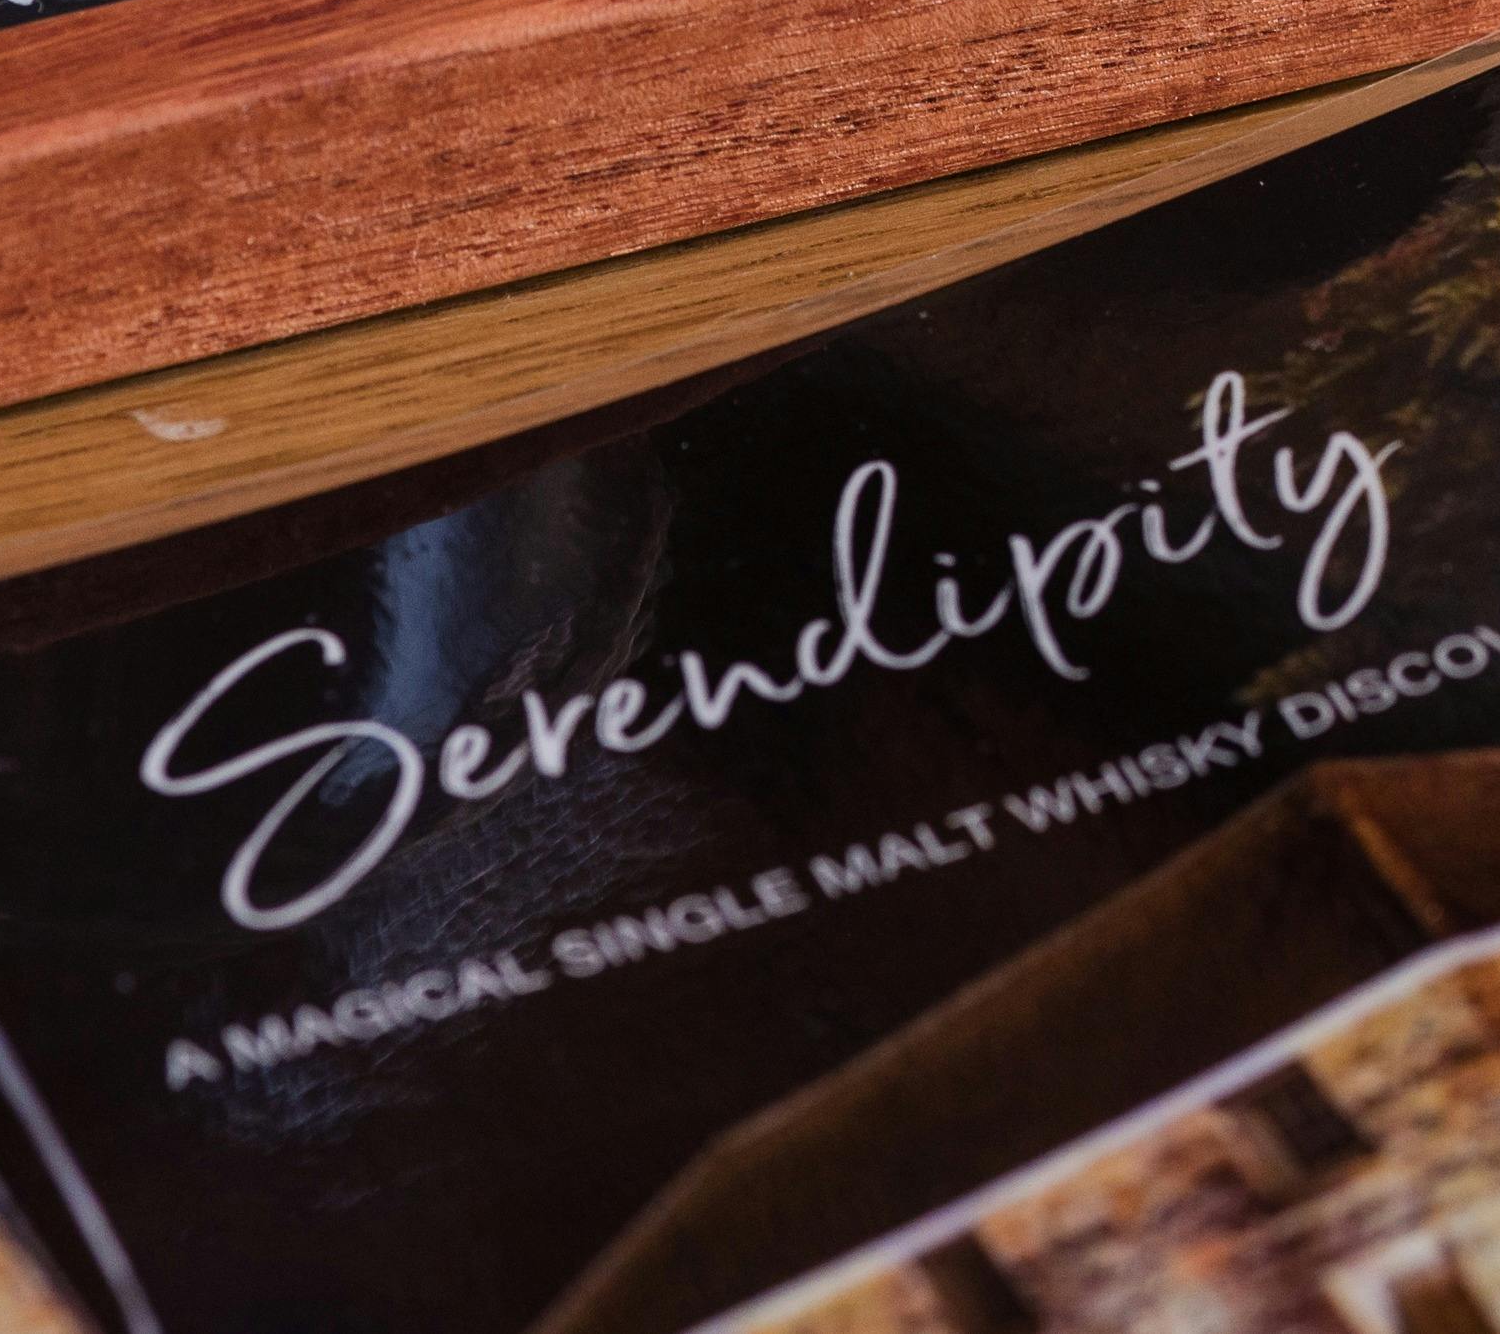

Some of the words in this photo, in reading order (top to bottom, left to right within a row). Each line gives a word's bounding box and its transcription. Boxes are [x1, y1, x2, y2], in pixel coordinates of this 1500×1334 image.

[141, 369, 1406, 932] Serendipity
[164, 1037, 222, 1093] A
[222, 955, 552, 1076] MAGICAL
[551, 869, 813, 982] SINGLE
[808, 803, 998, 905] MALT
[1003, 724, 1271, 836] WHISKY
